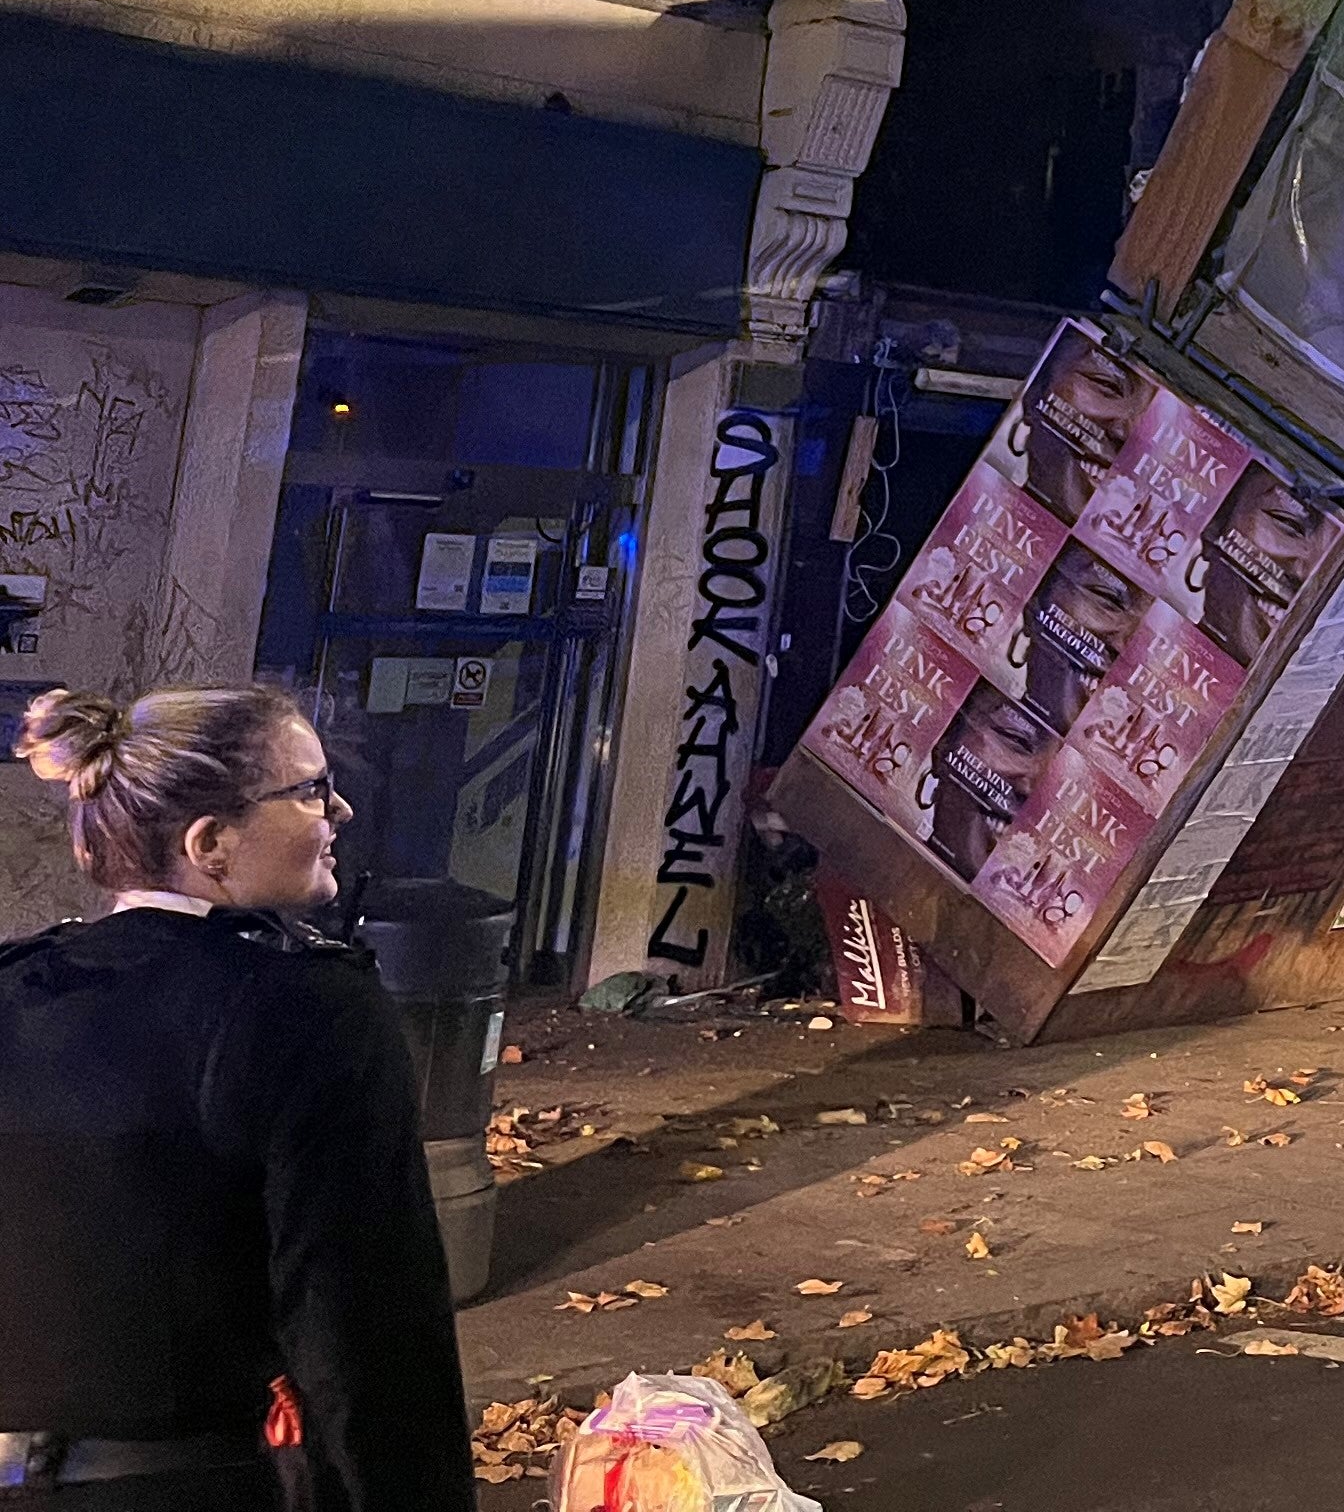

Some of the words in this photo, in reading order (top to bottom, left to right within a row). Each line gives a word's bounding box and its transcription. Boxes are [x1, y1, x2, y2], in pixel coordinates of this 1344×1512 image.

[1132, 452, 1208, 515] FEST
[1152, 420, 1228, 488] PINK
[953, 524, 1025, 586] FEST
[971, 492, 1044, 559] PINK
[1035, 610, 1106, 668] MAKEOVERS
[1048, 603, 1079, 629] FREE
[1077, 626, 1107, 653] MINI
[864, 664, 934, 727] FEST
[883, 636, 954, 700] PINK
[1127, 663, 1199, 728] FEST
[1147, 634, 1221, 702] PINK
[945, 751, 1011, 810] MAKEOVERS
[956, 744, 986, 771] FREE
[984, 765, 1014, 795] MINI
[1035, 809, 1107, 874] FEST
[1055, 777, 1129, 848] PINK
[843, 899, 880, 1008] Malkin
[891, 927, 907, 967] BUILDS
